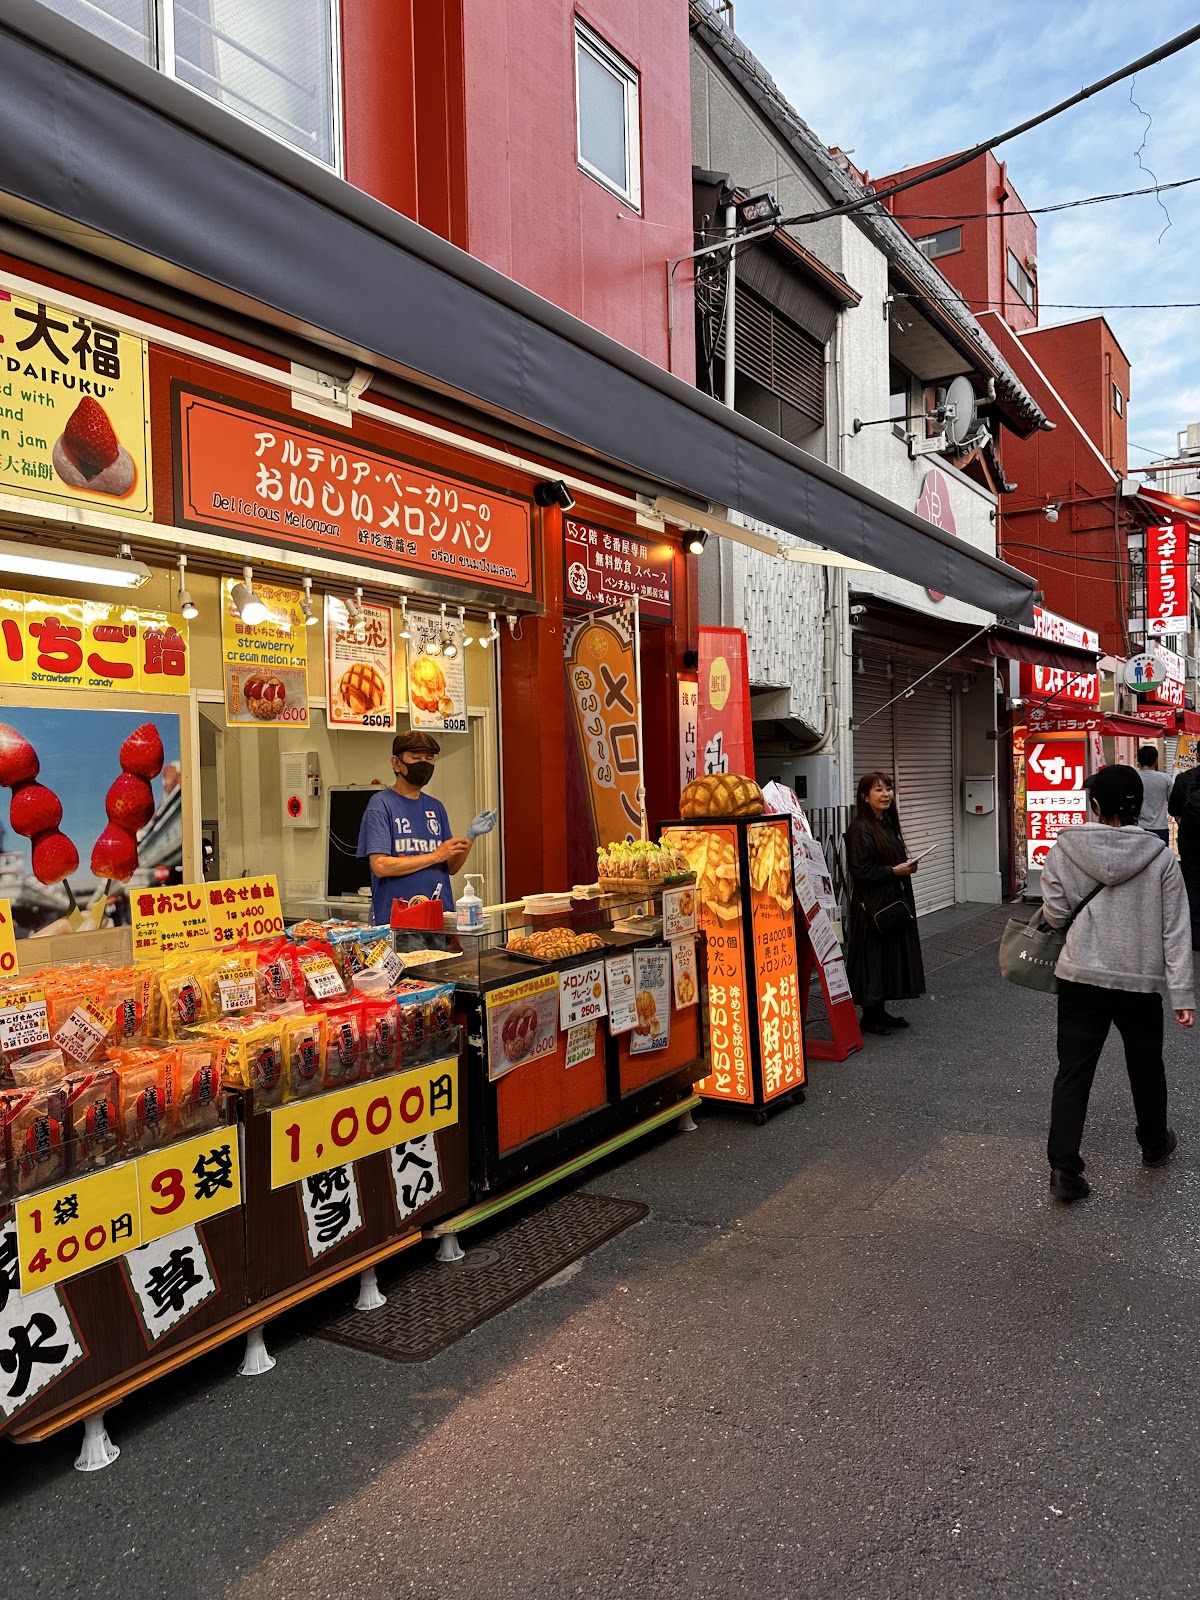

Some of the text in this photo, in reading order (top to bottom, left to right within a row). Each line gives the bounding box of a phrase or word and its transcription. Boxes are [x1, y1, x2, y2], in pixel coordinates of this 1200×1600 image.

[0, 290, 120, 380] 大福
[21, 390, 55, 408] with
[18, 431, 47, 449] jam
[0, 454, 54, 481] 大福餅
[212, 493, 341, 537] Delicious Melonpan
[255, 462, 492, 553] おいしいメロンパン
[579, 526, 598, 546] 2階
[594, 550, 668, 585] 無料飲食 スペース
[1157, 525, 1179, 618] スギドラッグ
[237, 637, 295, 653] strawberry
[226, 651, 259, 662] cream
[260, 653, 288, 665] melon
[31, 671, 114, 688] Strawberry candy
[362, 715, 391, 728] 250円
[443, 719, 467, 731] 500円
[1029, 719, 1101, 732] スギドラッグ
[1028, 743, 1084, 790] くすり
[1029, 797, 1084, 805] スギドラッグ
[395, 818, 412, 834] 12
[1045, 812, 1084, 825] 化粧品
[137, 891, 202, 917] 雷おこし
[210, 883, 275, 906] 組合せ自由
[241, 905, 265, 918] ¥400
[213, 927, 235, 942] 3袋
[706, 936, 737, 949] 00個
[757, 925, 793, 945] 1日4000個
[764, 942, 787, 959] 売れた
[759, 954, 793, 976] メロンパン
[563, 969, 601, 991] メロンパン
[581, 1004, 601, 1018] 250円
[709, 984, 731, 1093] おいしいと
[729, 985, 746, 1095] 冷めても次の日でも
[761, 981, 783, 1093] 大好評
[779, 976, 794, 1083] おいしいと
[285, 1074, 452, 1162] 1,000円
[150, 1145, 233, 1215] 3袋
[30, 1194, 79, 1234] 1袋
[28, 1213, 133, 1273] 400円
